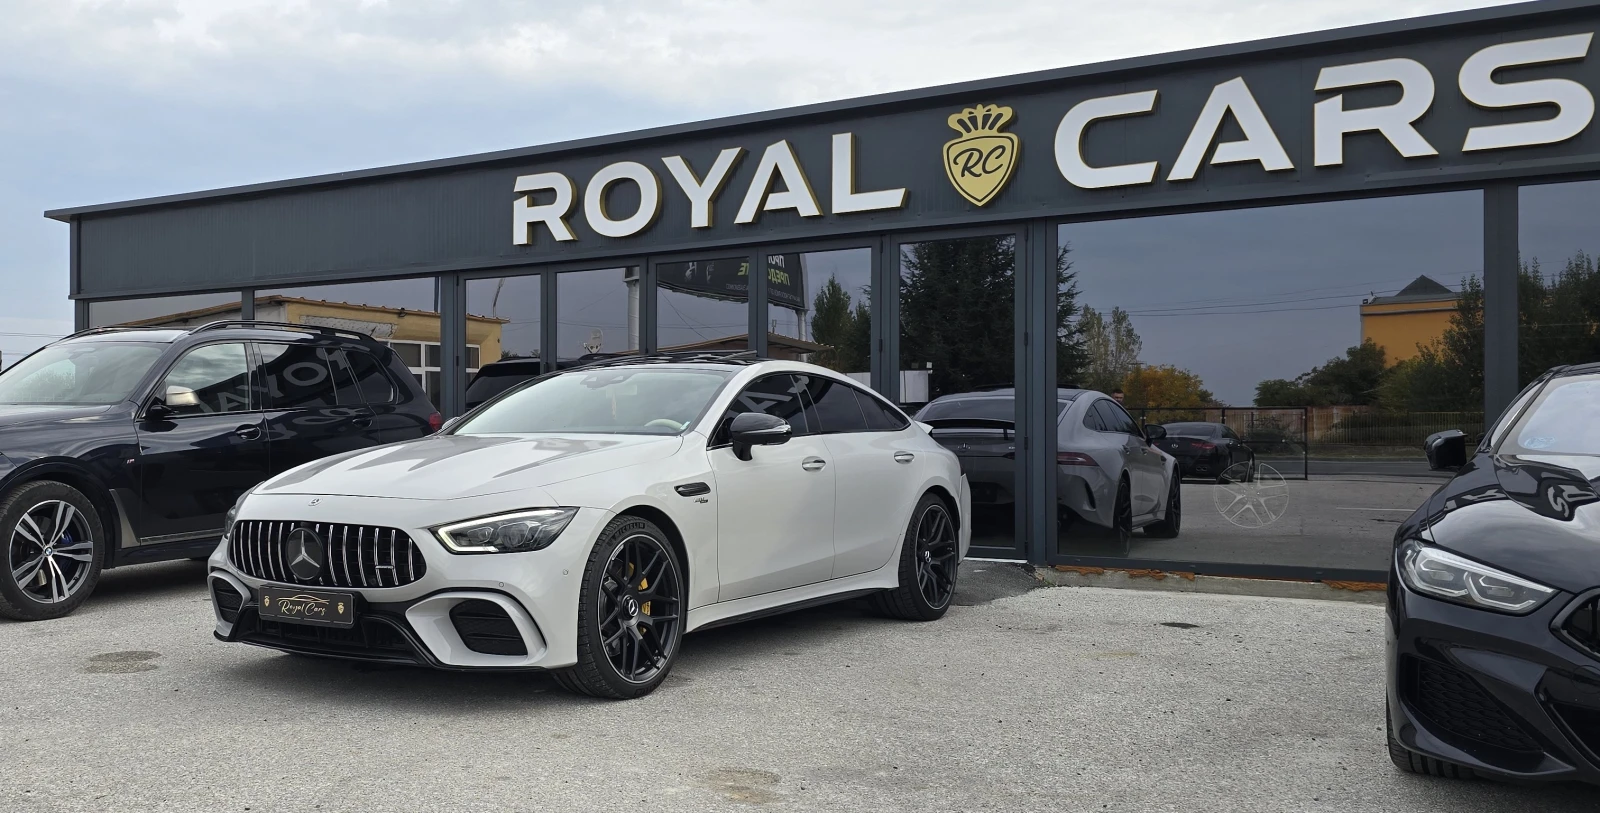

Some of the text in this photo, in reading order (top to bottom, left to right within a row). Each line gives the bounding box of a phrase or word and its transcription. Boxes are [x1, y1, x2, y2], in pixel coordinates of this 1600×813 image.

[512, 31, 1597, 246] ROYAL CARS
[953, 144, 1006, 178] RC
[279, 600, 326, 615] Royal Cars
